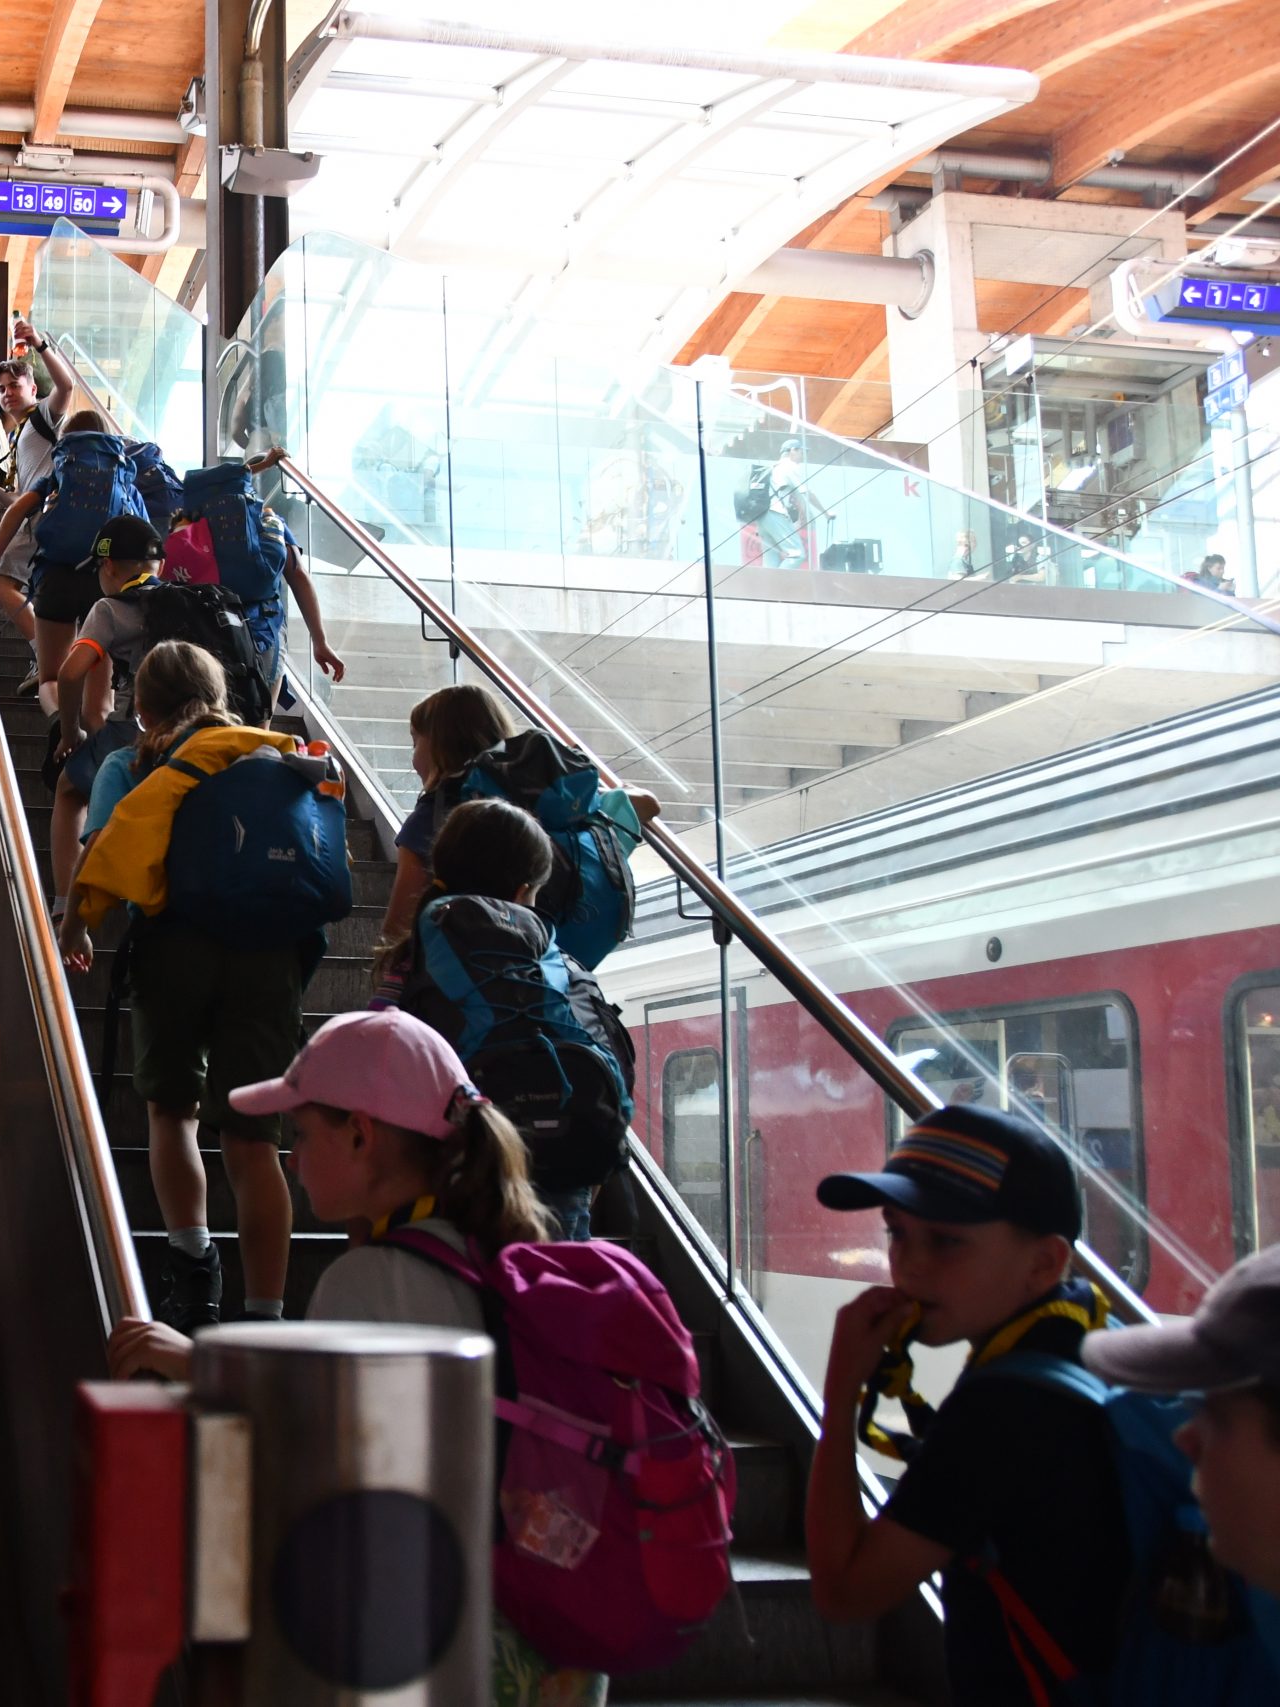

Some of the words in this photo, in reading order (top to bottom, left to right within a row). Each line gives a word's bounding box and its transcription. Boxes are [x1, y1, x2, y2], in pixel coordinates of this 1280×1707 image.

[16, 195, 34, 209] 13
[44, 196, 63, 210] 49
[73, 198, 92, 212] 50
[1214, 290, 1222, 305] 1
[1249, 292, 1260, 308] 4
